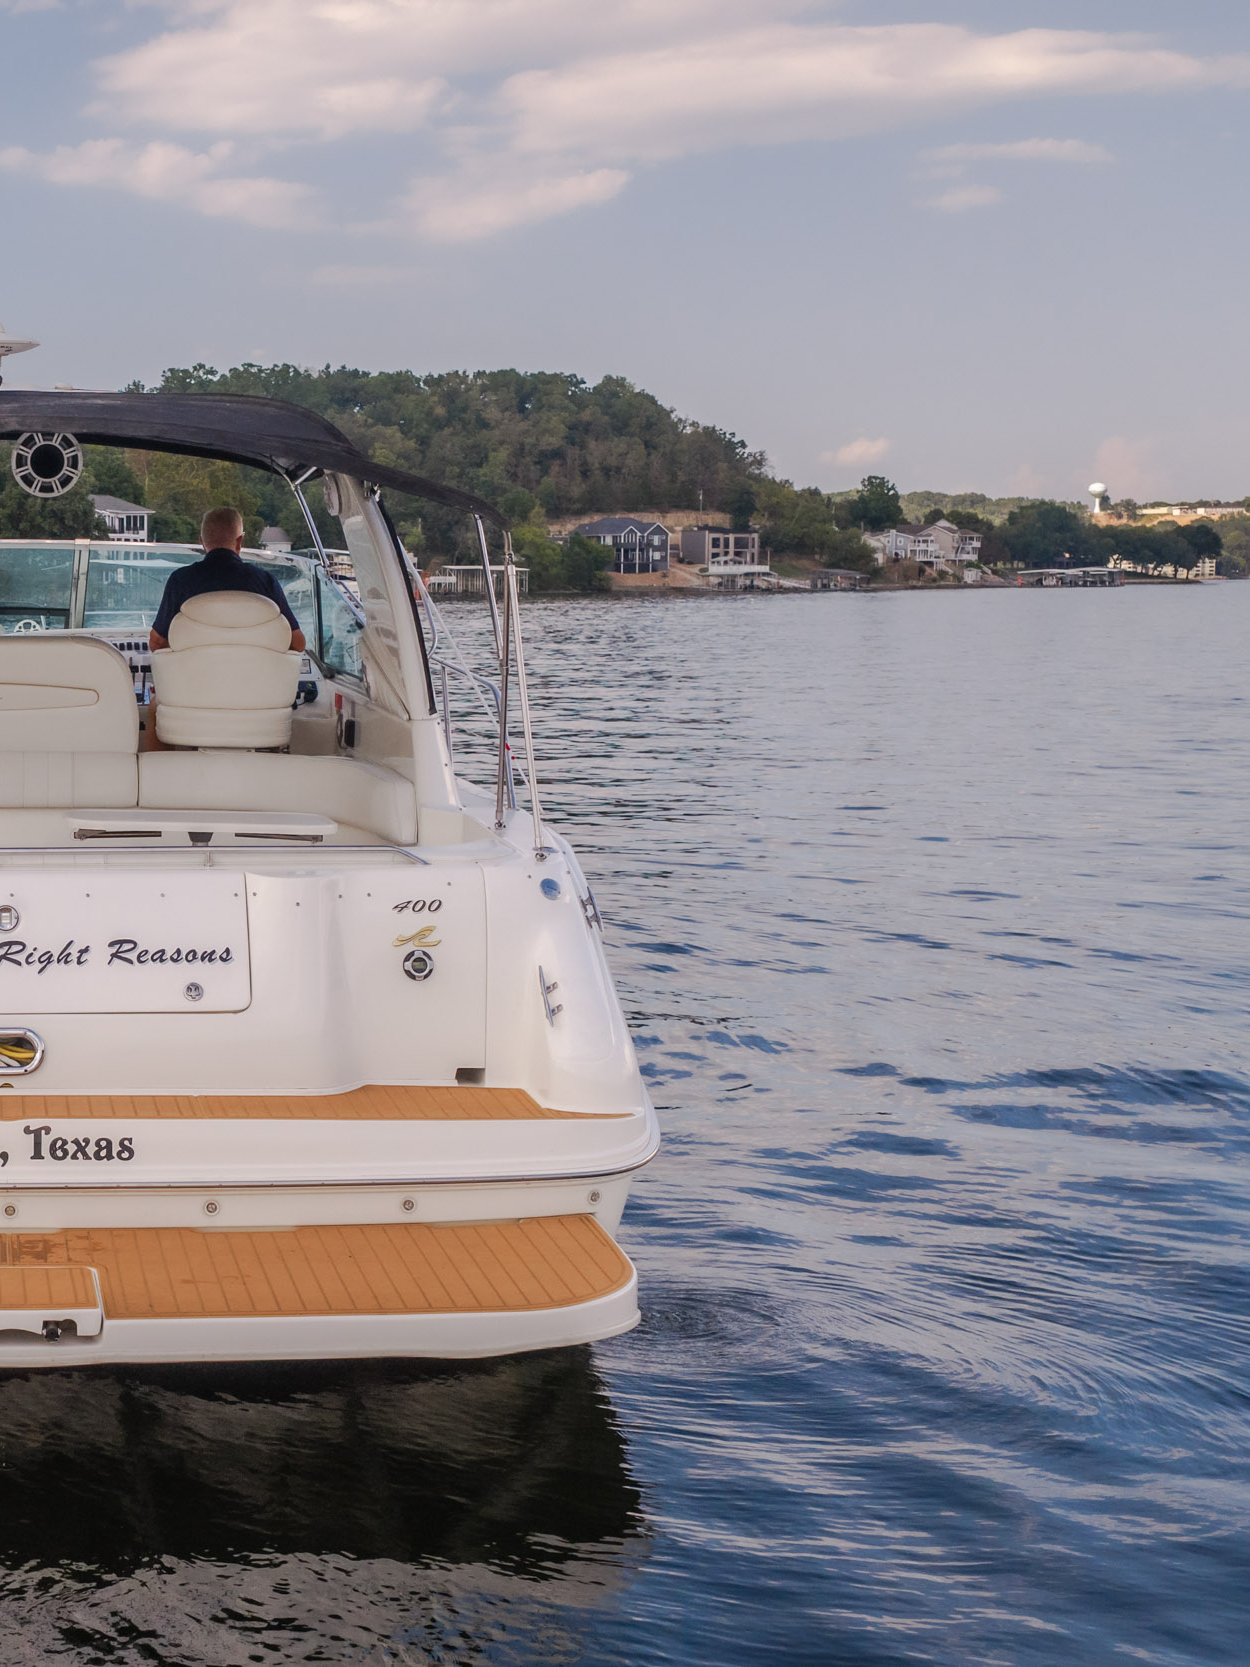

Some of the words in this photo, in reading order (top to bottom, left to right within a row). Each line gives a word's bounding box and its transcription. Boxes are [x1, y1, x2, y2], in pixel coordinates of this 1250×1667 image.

[392, 899, 442, 913] 400
[107, 938, 234, 967] Reasons
[23, 1124, 135, 1161] Texas
